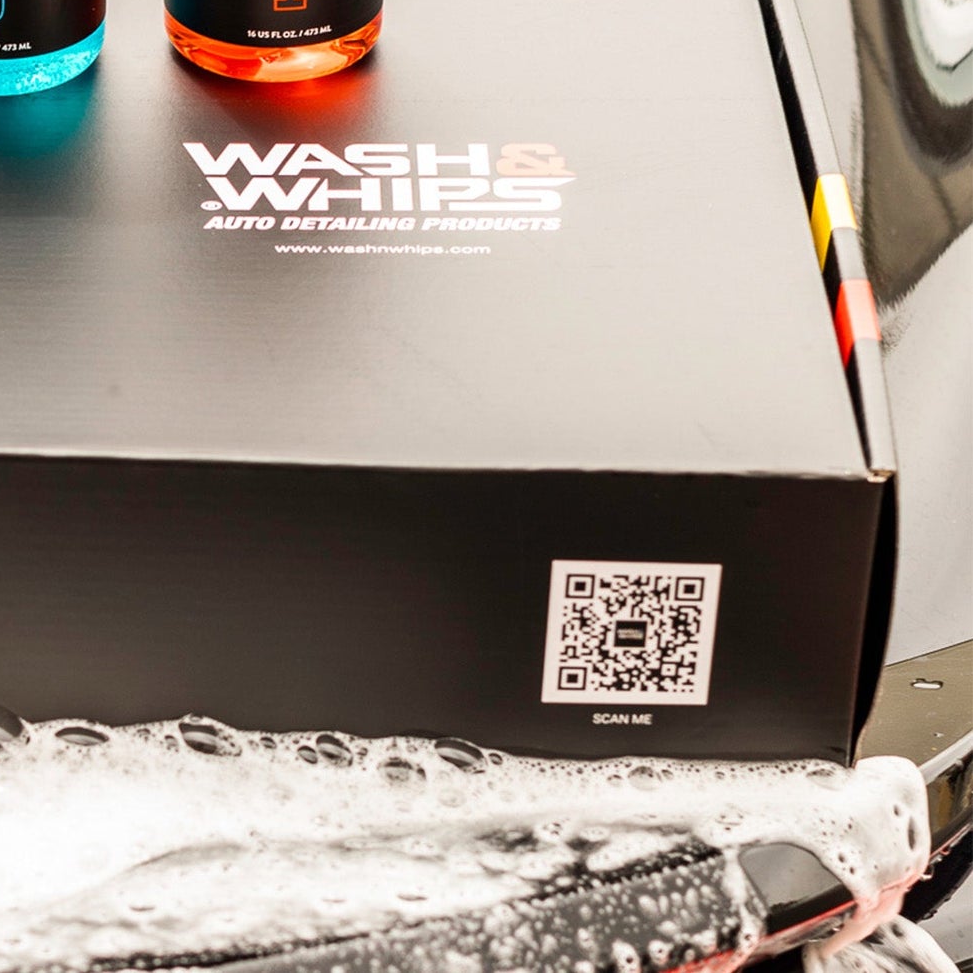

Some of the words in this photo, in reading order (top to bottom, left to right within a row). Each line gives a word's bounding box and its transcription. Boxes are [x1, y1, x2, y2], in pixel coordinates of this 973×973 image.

[247, 30, 256, 38] 16
[258, 31, 269, 39] US
[304, 27, 319, 36] 473
[319, 25, 332, 33] ML
[18, 42, 31, 51] ML
[206, 177, 577, 211] WHIPS
[203, 216, 275, 230] AUTO
[280, 216, 414, 231] DETAILING
[421, 216, 561, 231] PRODUCTS
[274, 244, 491, 255] www.washnwhips.com
[592, 713, 630, 725] SCAN
[631, 713, 653, 725] ME
